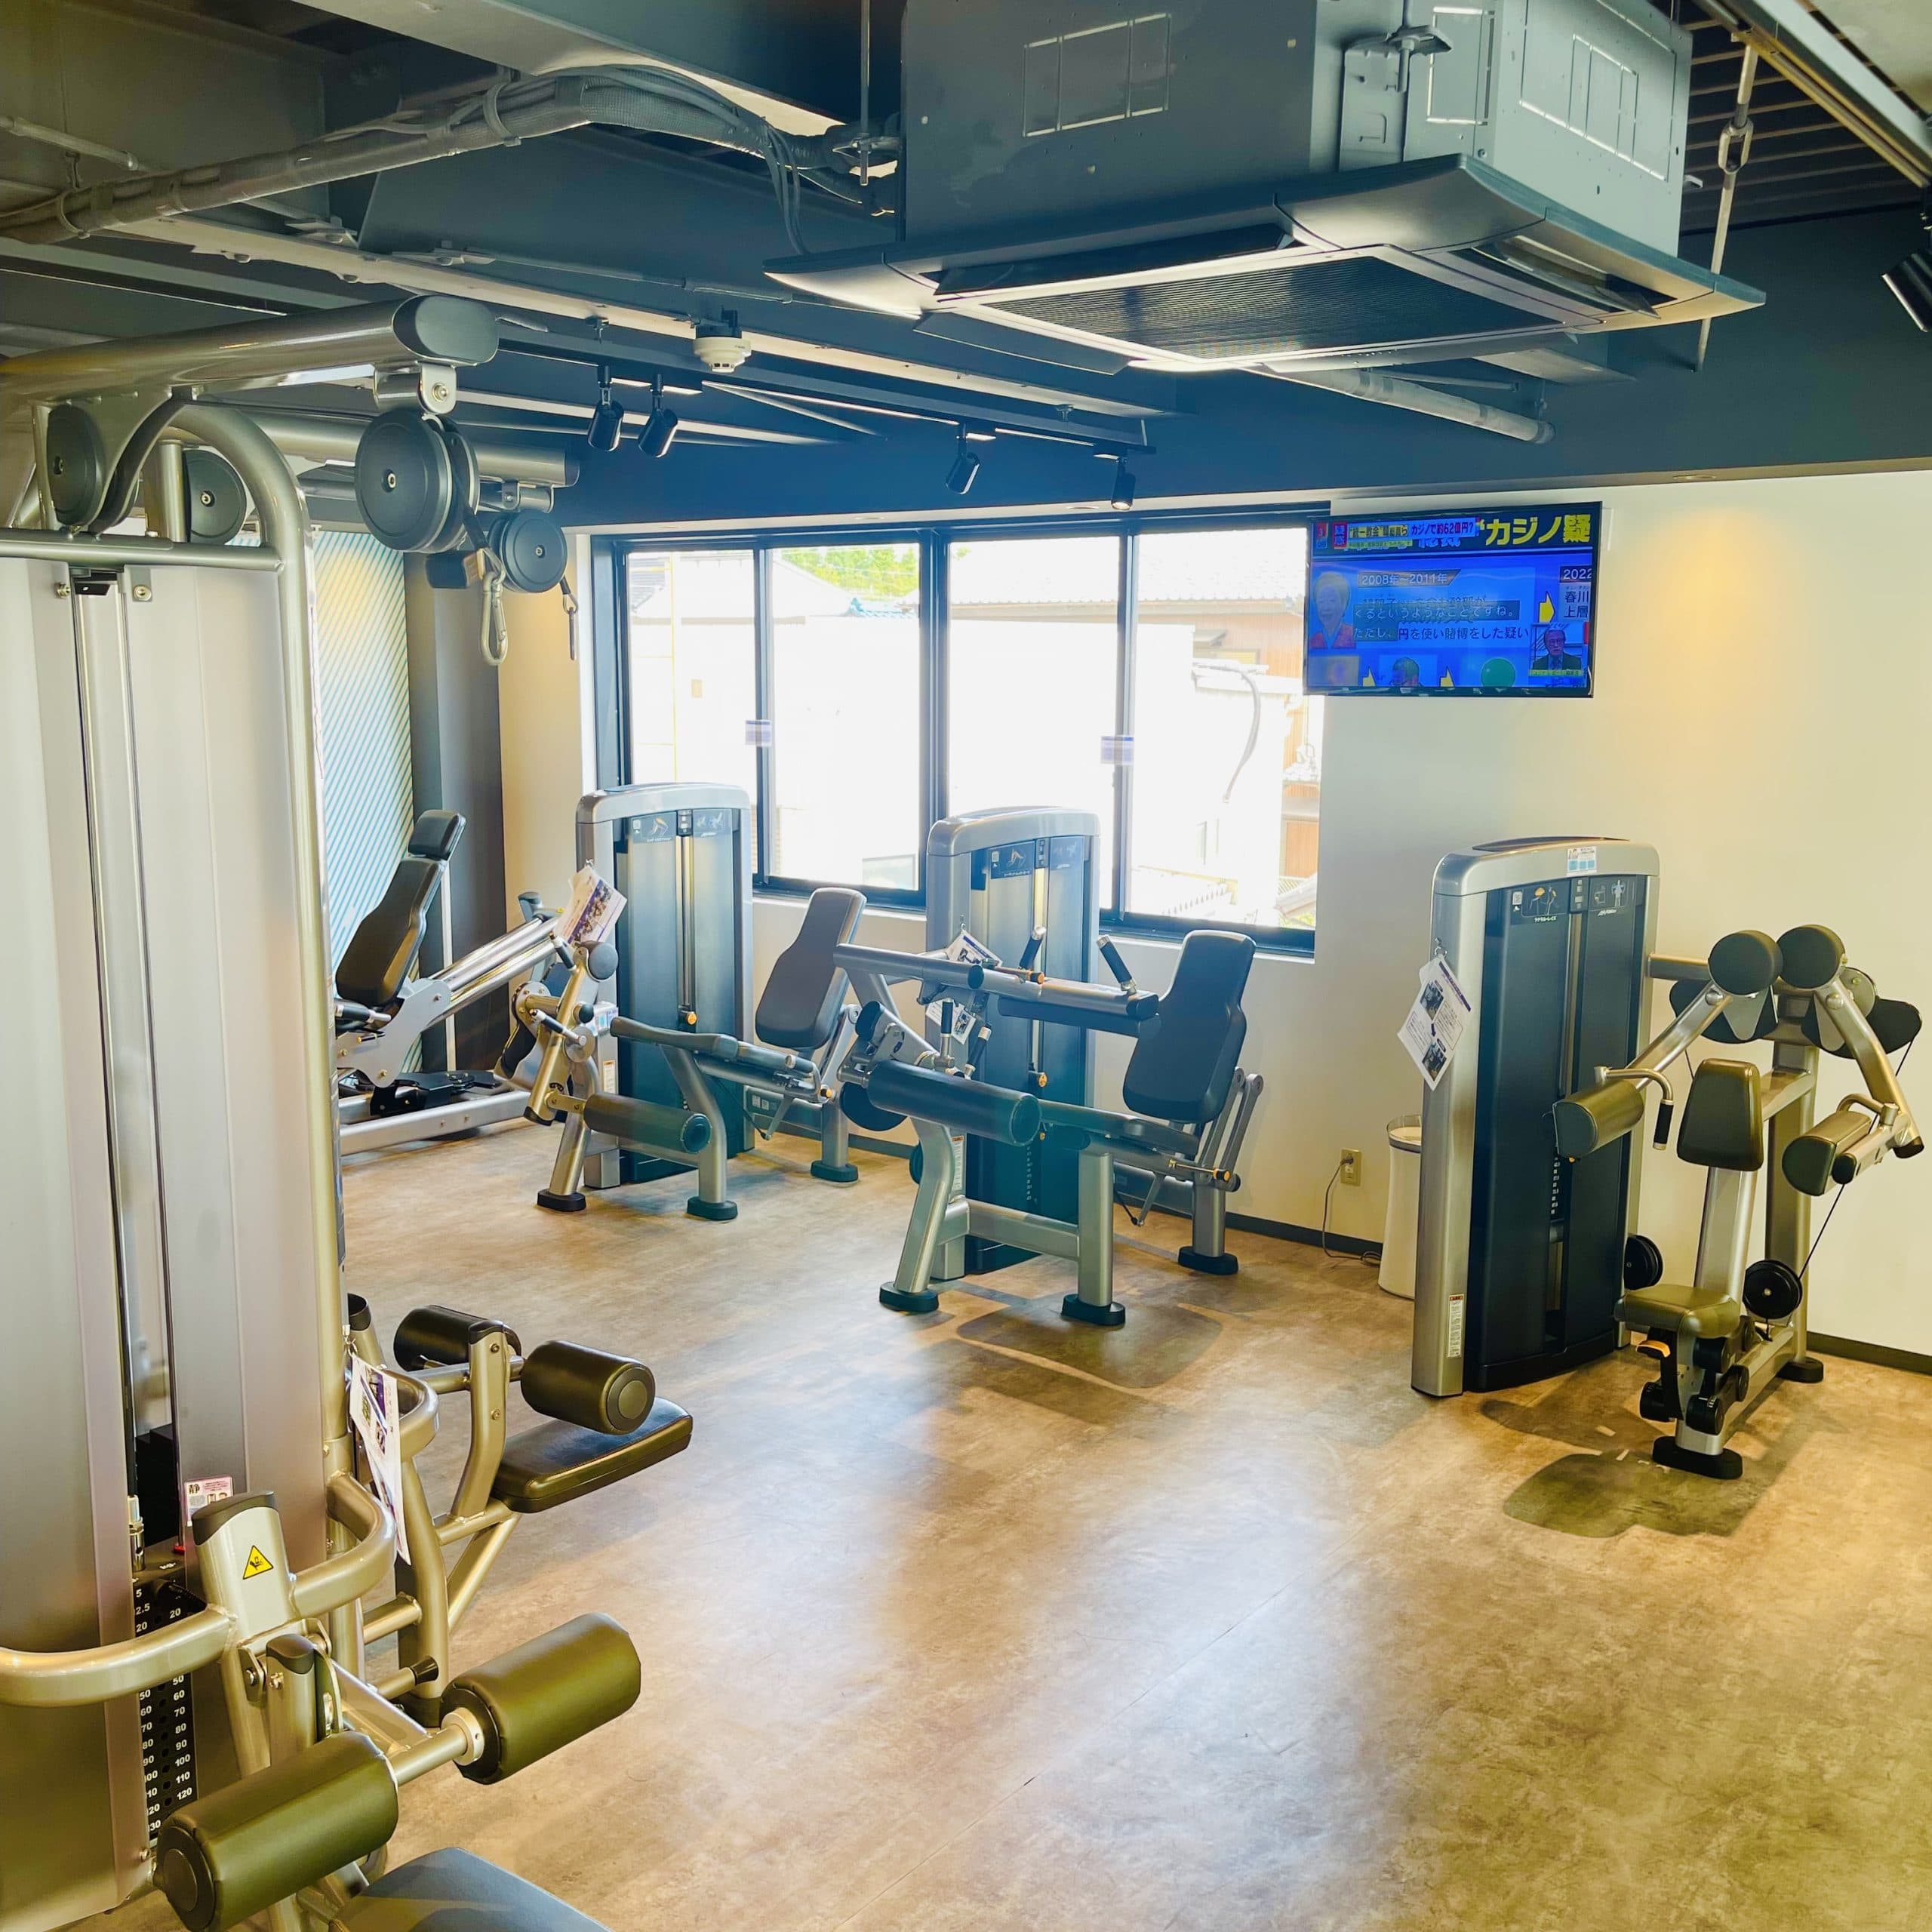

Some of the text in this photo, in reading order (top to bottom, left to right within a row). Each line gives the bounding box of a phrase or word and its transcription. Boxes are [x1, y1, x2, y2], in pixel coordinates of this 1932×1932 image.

[169, 1607, 181, 1620] 20
[135, 1621, 148, 1633] 20
[172, 1675, 185, 1686] 50
[139, 1689, 151, 1701] 50
[173, 1689, 186, 1701] 60
[140, 1705, 152, 1717] 60
[174, 1706, 186, 1718] 70
[140, 1721, 153, 1734] 70
[174, 1722, 187, 1734] 80
[142, 1738, 154, 1750] 80
[175, 1739, 188, 1751] 90
[143, 1755, 155, 1767] 90
[174, 1753, 191, 1767] 100
[175, 1770, 191, 1784] 110
[176, 1786, 192, 1801] 120
